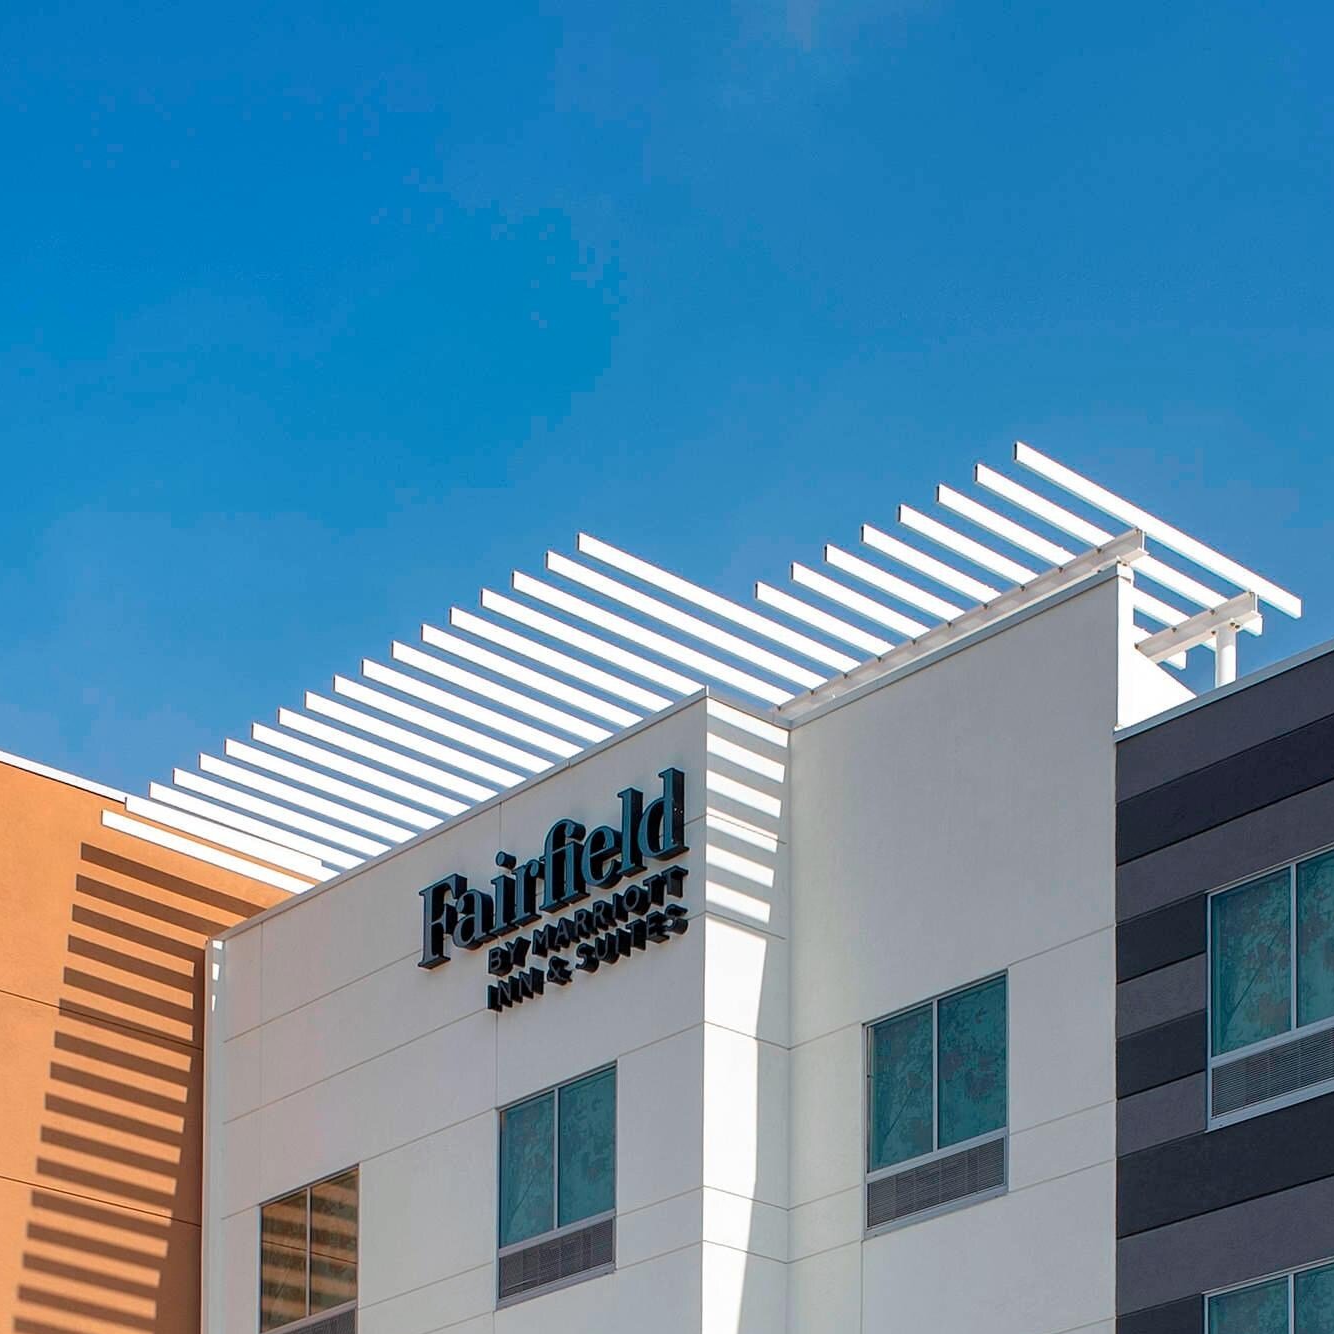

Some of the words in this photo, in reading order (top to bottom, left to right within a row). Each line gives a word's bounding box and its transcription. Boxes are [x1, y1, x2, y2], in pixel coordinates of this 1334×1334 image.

[418, 767, 689, 969] Fairfield
[488, 937, 531, 976] BY
[532, 865, 688, 957] MARRIOTT
[487, 967, 544, 1012] INN
[547, 955, 572, 985] &
[576, 904, 688, 973] SUITES
